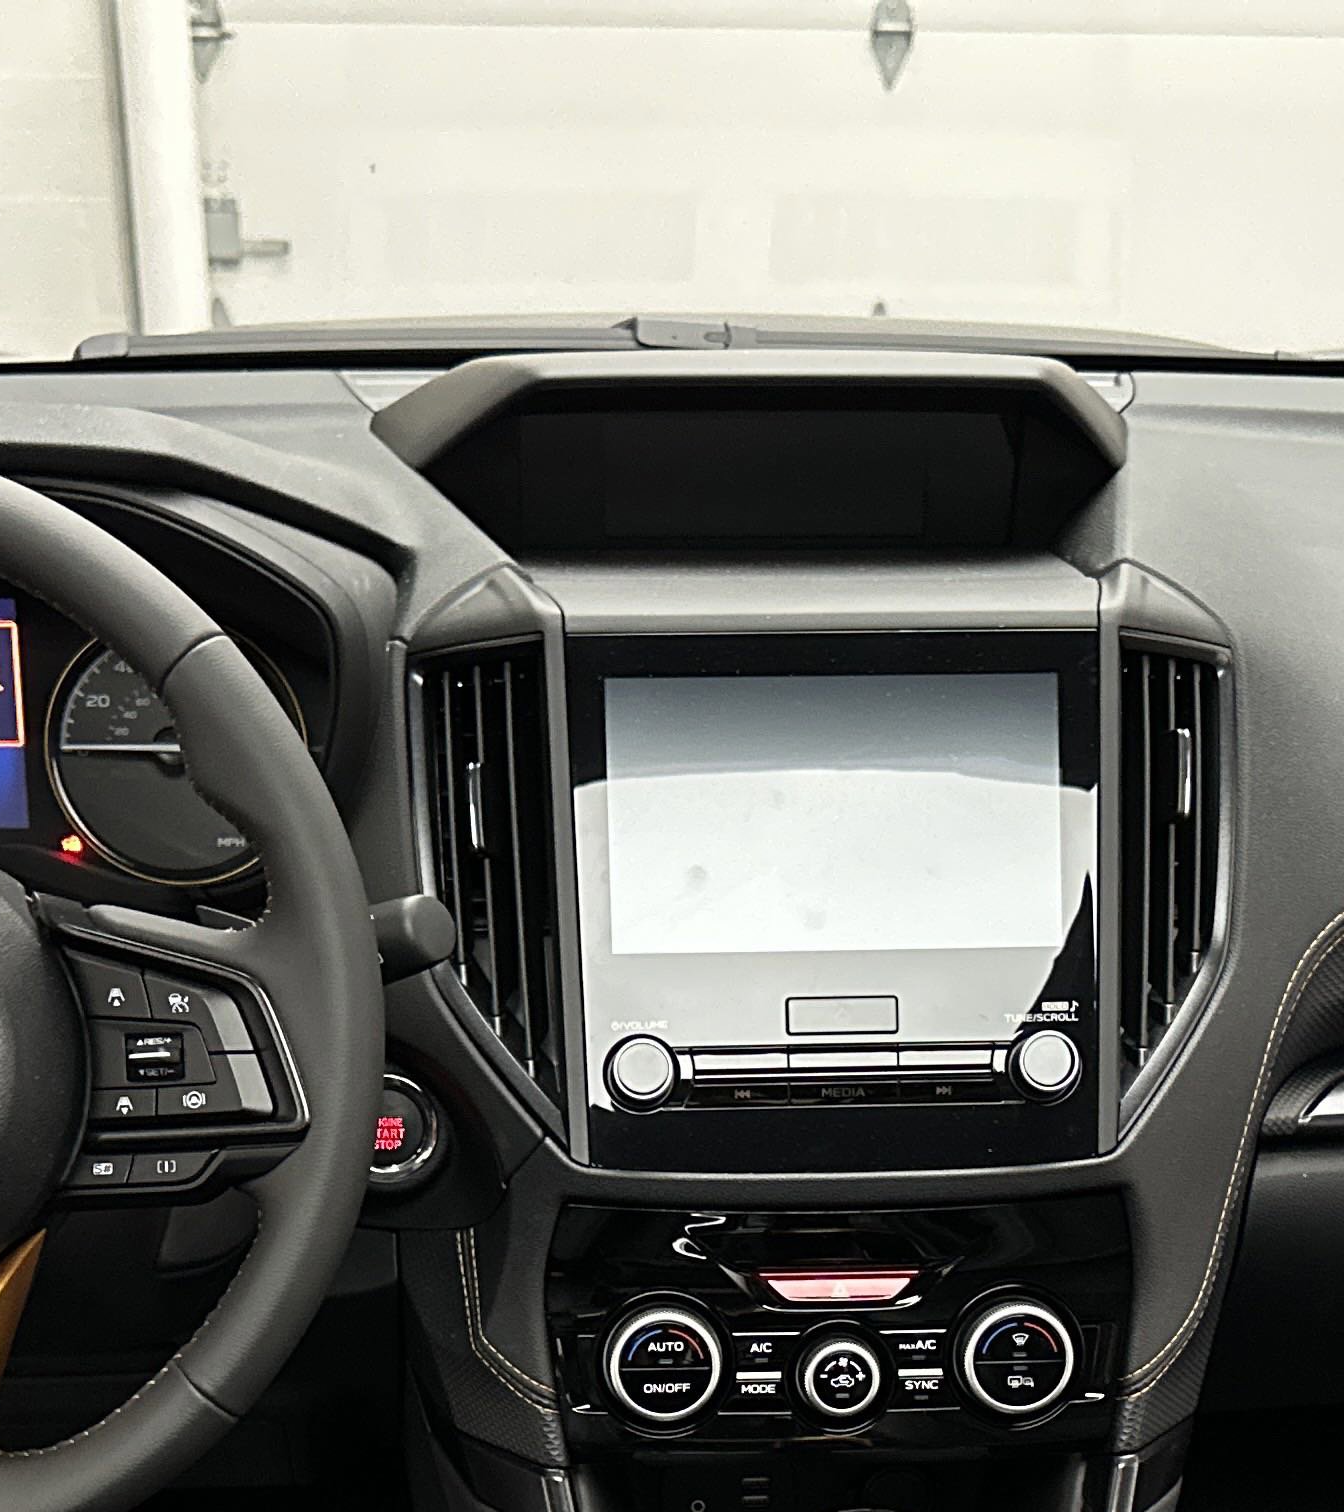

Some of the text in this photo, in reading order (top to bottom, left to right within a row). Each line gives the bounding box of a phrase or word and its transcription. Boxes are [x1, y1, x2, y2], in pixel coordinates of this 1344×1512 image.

[86, 694, 110, 708] 20
[217, 837, 246, 848] MPH
[1003, 1012, 1079, 1023] TUNE/SCROLL
[821, 1086, 865, 1098] MEDIA
[378, 1117, 403, 1127] GINE
[376, 1128, 405, 1139] TART
[647, 1341, 684, 1353] AUTO
[749, 1342, 773, 1354] A/C
[915, 1339, 937, 1350] A/C
[643, 1382, 691, 1395] ON/OFF
[741, 1384, 776, 1395] MODE
[904, 1379, 939, 1391] SYNC
